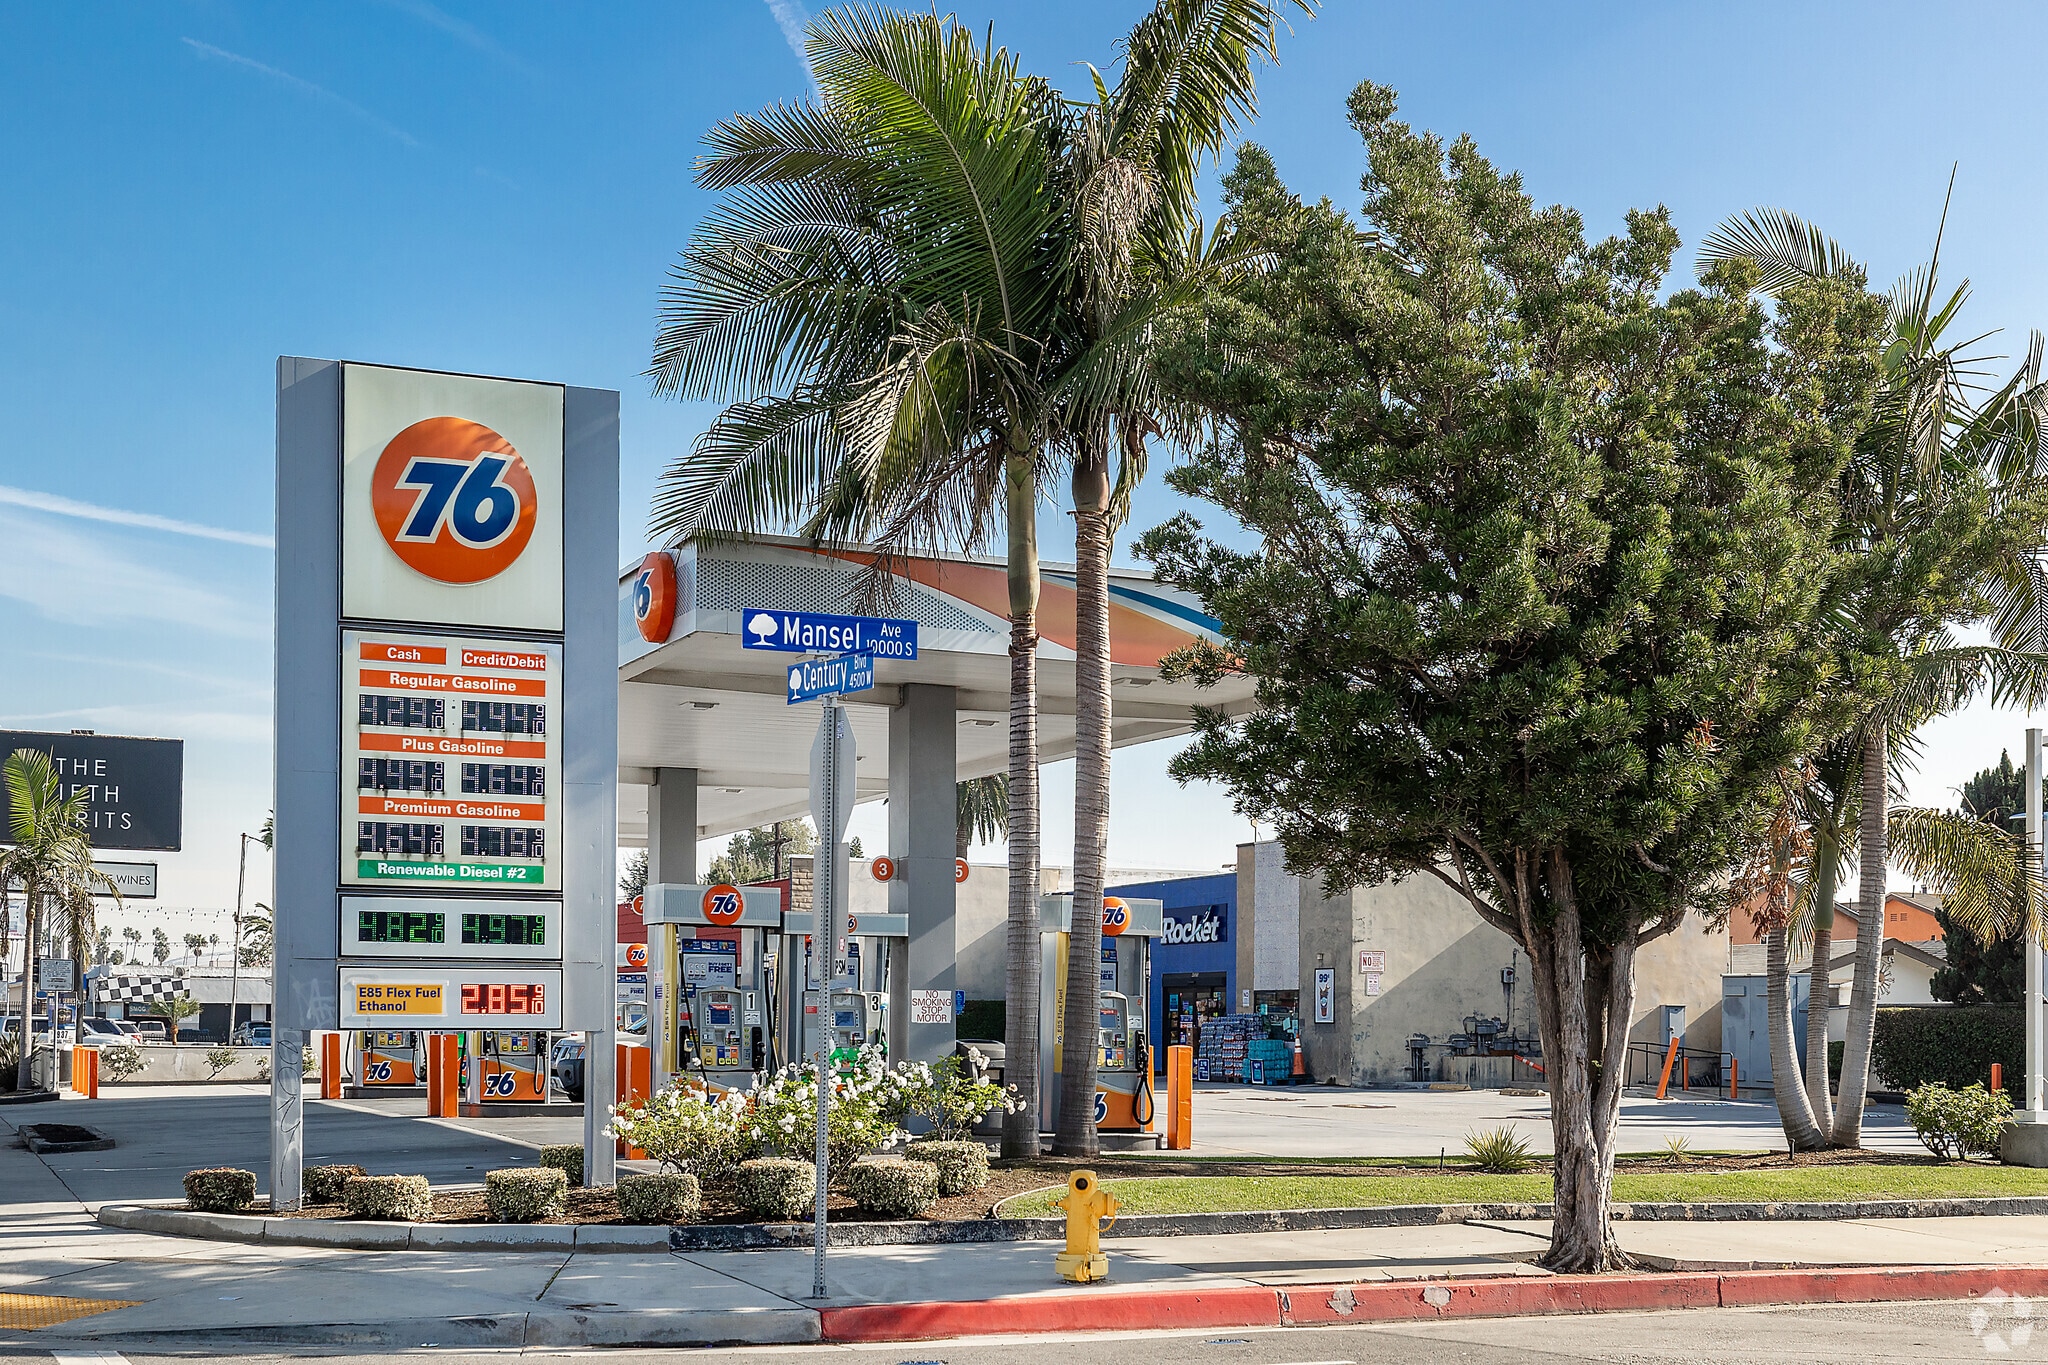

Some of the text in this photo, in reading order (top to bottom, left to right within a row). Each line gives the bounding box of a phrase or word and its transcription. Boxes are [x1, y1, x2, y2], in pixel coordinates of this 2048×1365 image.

[394, 451, 521, 550] 76
[632, 568, 655, 622] 6
[783, 616, 860, 650] Mansel
[880, 622, 902, 638] Ave
[387, 647, 421, 661] Cash
[866, 638, 913, 657] 10000 S
[463, 652, 545, 669] Credit/Debit
[854, 654, 867, 670] Blvd
[389, 673, 517, 692] Regular Gasoline
[803, 661, 848, 691] Century
[849, 669, 872, 688] 4500 W
[360, 695, 427, 728] 4.29
[463, 701, 528, 733] 4.44
[402, 738, 504, 754] Plus Gasoline
[56, 757, 107, 776] THE
[359, 758, 427, 790] 4.49
[462, 763, 528, 795] 4.64
[59, 783, 119, 803] IFTH
[384, 801, 521, 818] Premium Gasoline
[359, 822, 426, 853] 4.64
[377, 862, 527, 879] Renewable Diesel #2
[879, 863, 888, 876] 3
[956, 865, 963, 878] 5
[116, 874, 151, 886] WINES
[711, 893, 738, 915] 76
[1102, 906, 1126, 926] 76
[359, 911, 427, 942] 4.82
[462, 914, 528, 944] 4.97
[1160, 915, 1220, 944] Rocket
[630, 949, 646, 961] 76
[1362, 956, 1372, 967] NO
[359, 987, 441, 998] E85 Flex Fuel
[461, 984, 528, 1014] 2.85
[748, 993, 755, 1009] 1
[925, 990, 939, 999] NO
[359, 1001, 407, 1011] Ethanol
[871, 995, 879, 1011] 3
[912, 998, 952, 1007] SMOKING
[921, 1005, 943, 1015] STOP
[916, 1014, 947, 1023] MOTOR
[366, 1060, 393, 1081] 76
[484, 1071, 516, 1097] 76
[1095, 1092, 1108, 1124] 6
